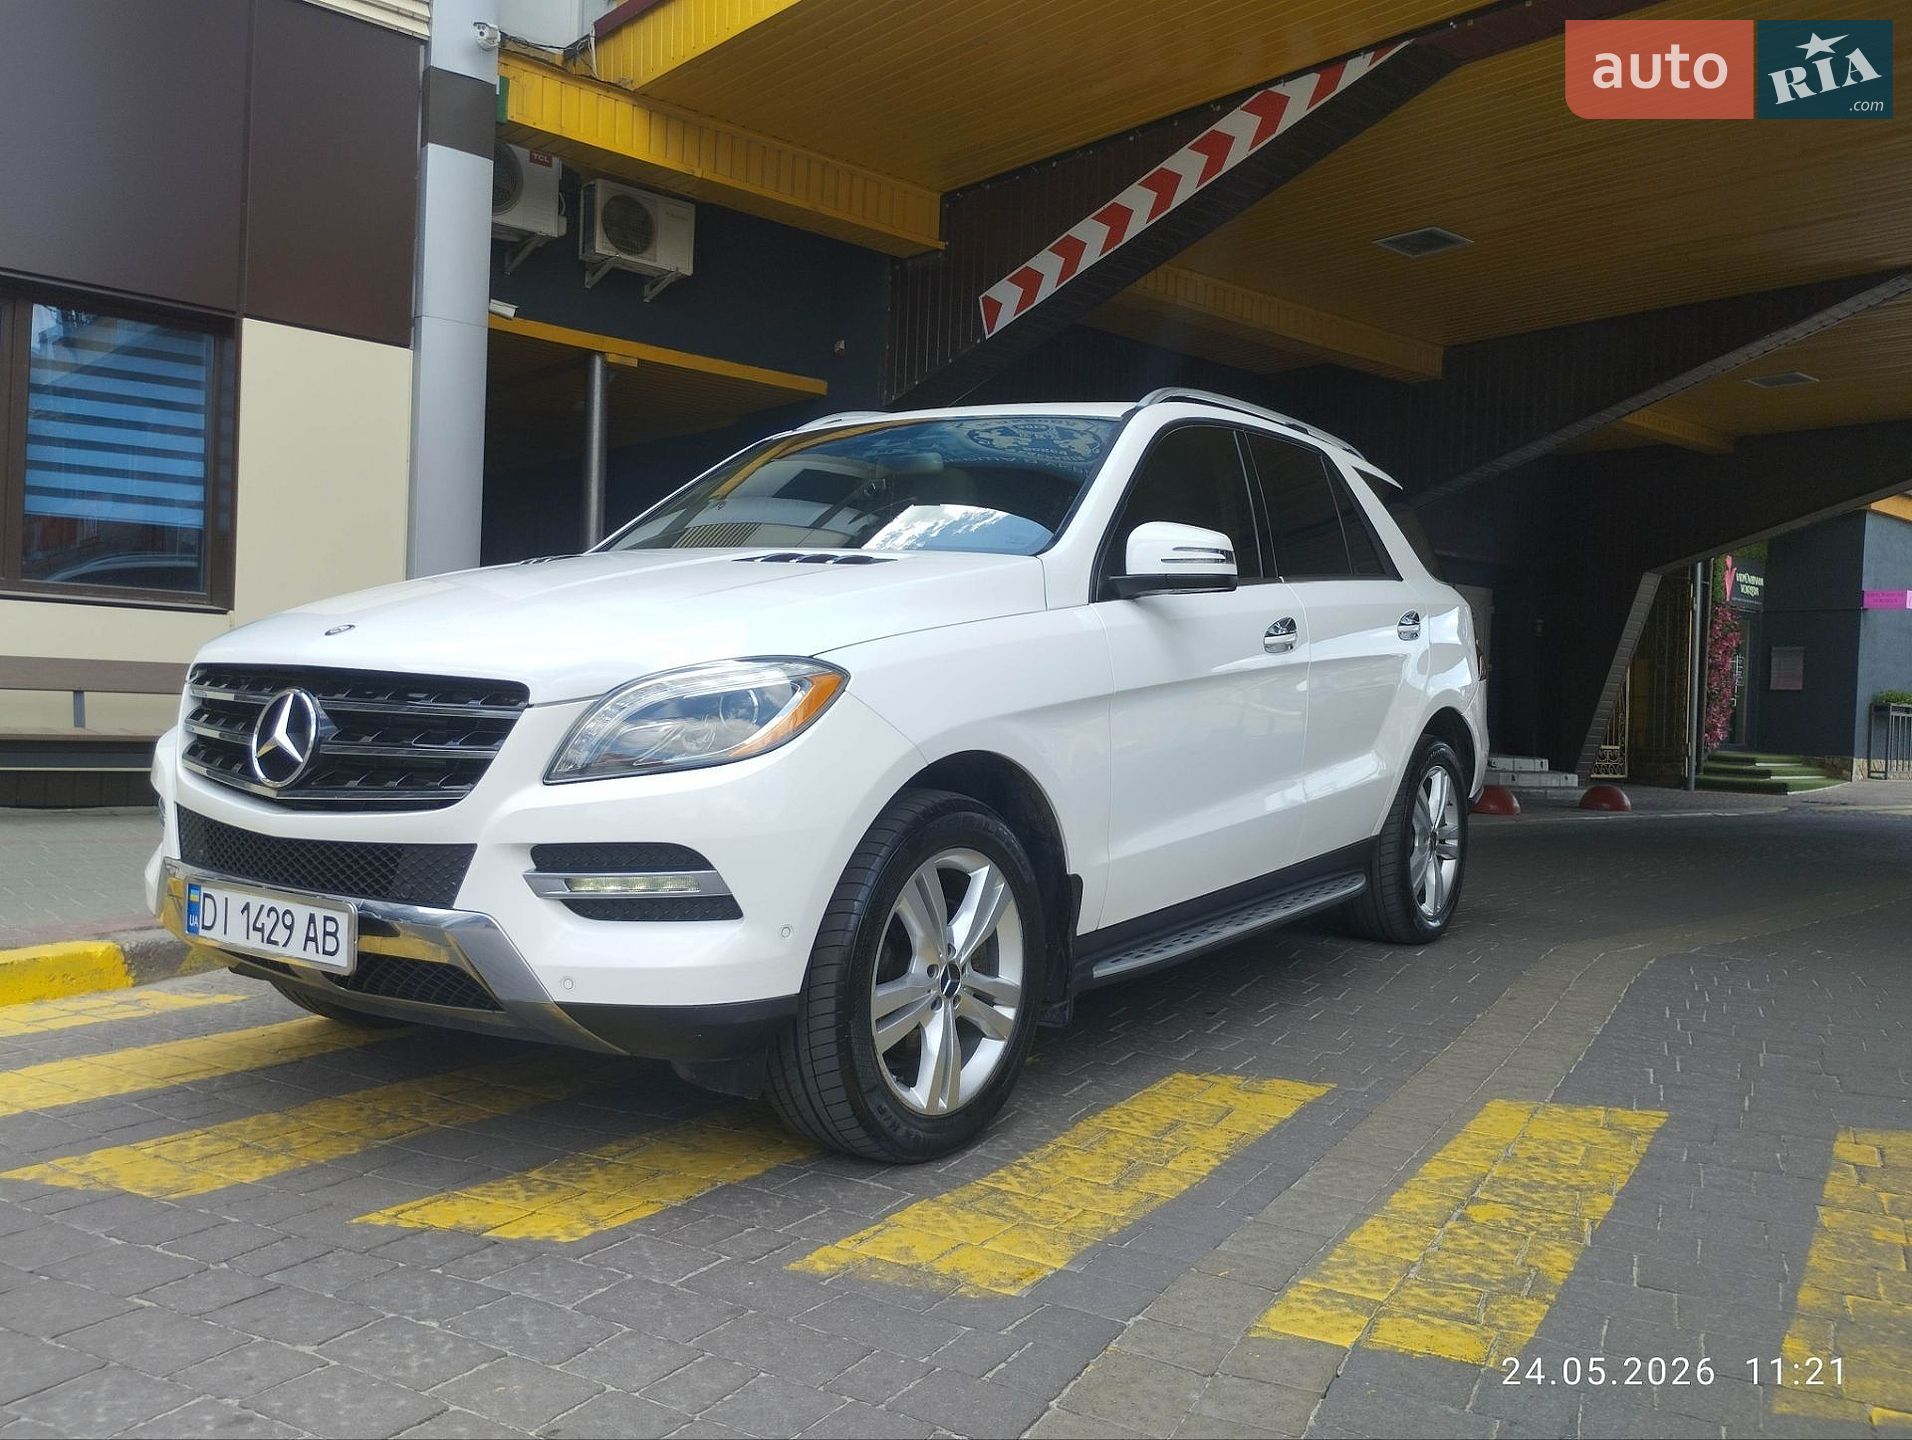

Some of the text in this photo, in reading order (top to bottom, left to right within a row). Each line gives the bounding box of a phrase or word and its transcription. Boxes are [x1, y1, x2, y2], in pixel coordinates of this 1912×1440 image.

[189, 914, 199, 927] UA
[201, 892, 341, 957] DI 1429 AB
